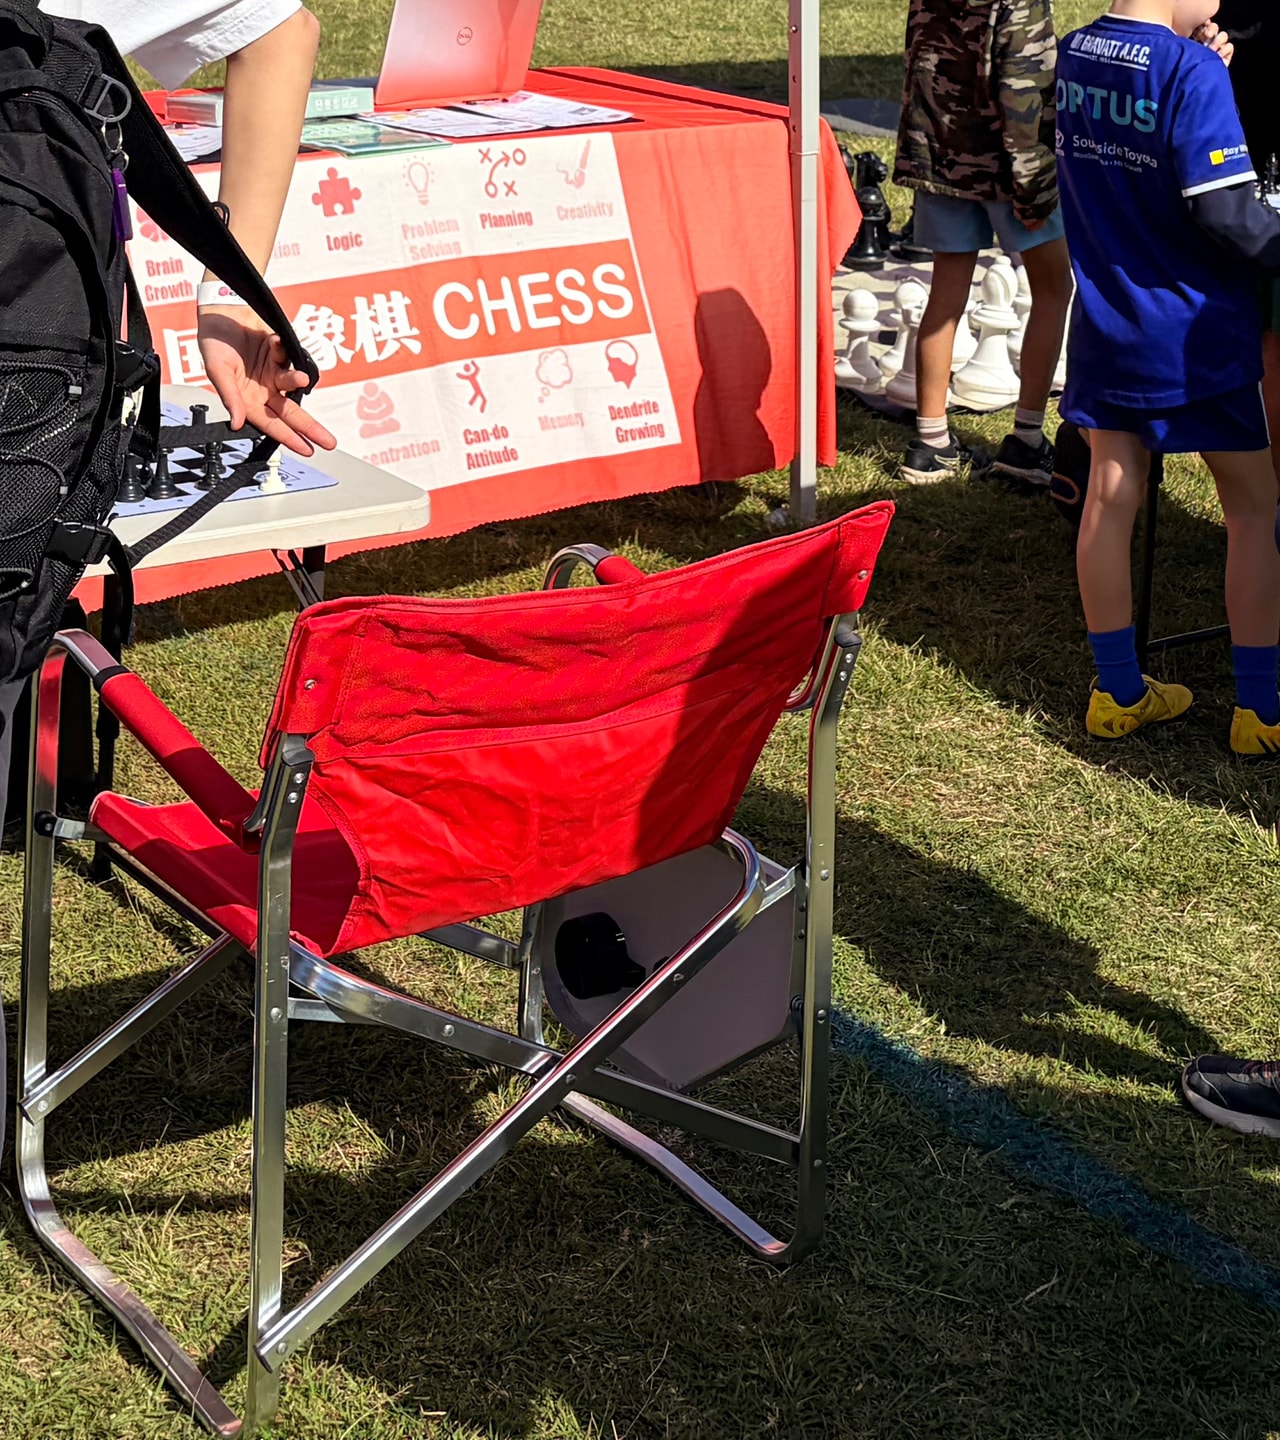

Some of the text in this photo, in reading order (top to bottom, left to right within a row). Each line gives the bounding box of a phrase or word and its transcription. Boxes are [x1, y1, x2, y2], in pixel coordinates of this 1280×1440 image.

[479, 209, 534, 231] Planning
[555, 200, 615, 224] Creativity
[401, 216, 460, 241] Problem
[326, 229, 364, 253] Logic
[409, 239, 462, 262] Solving
[145, 256, 185, 278] Brain
[144, 280, 194, 303] Growth
[162, 263, 634, 386] 国象棋 CHESS
[538, 411, 586, 433] Memory
[607, 397, 661, 425] Dendrite
[463, 423, 510, 448] Can-do
[613, 420, 667, 446] Growing
[362, 436, 442, 466] centration
[465, 445, 520, 472] Attitude
